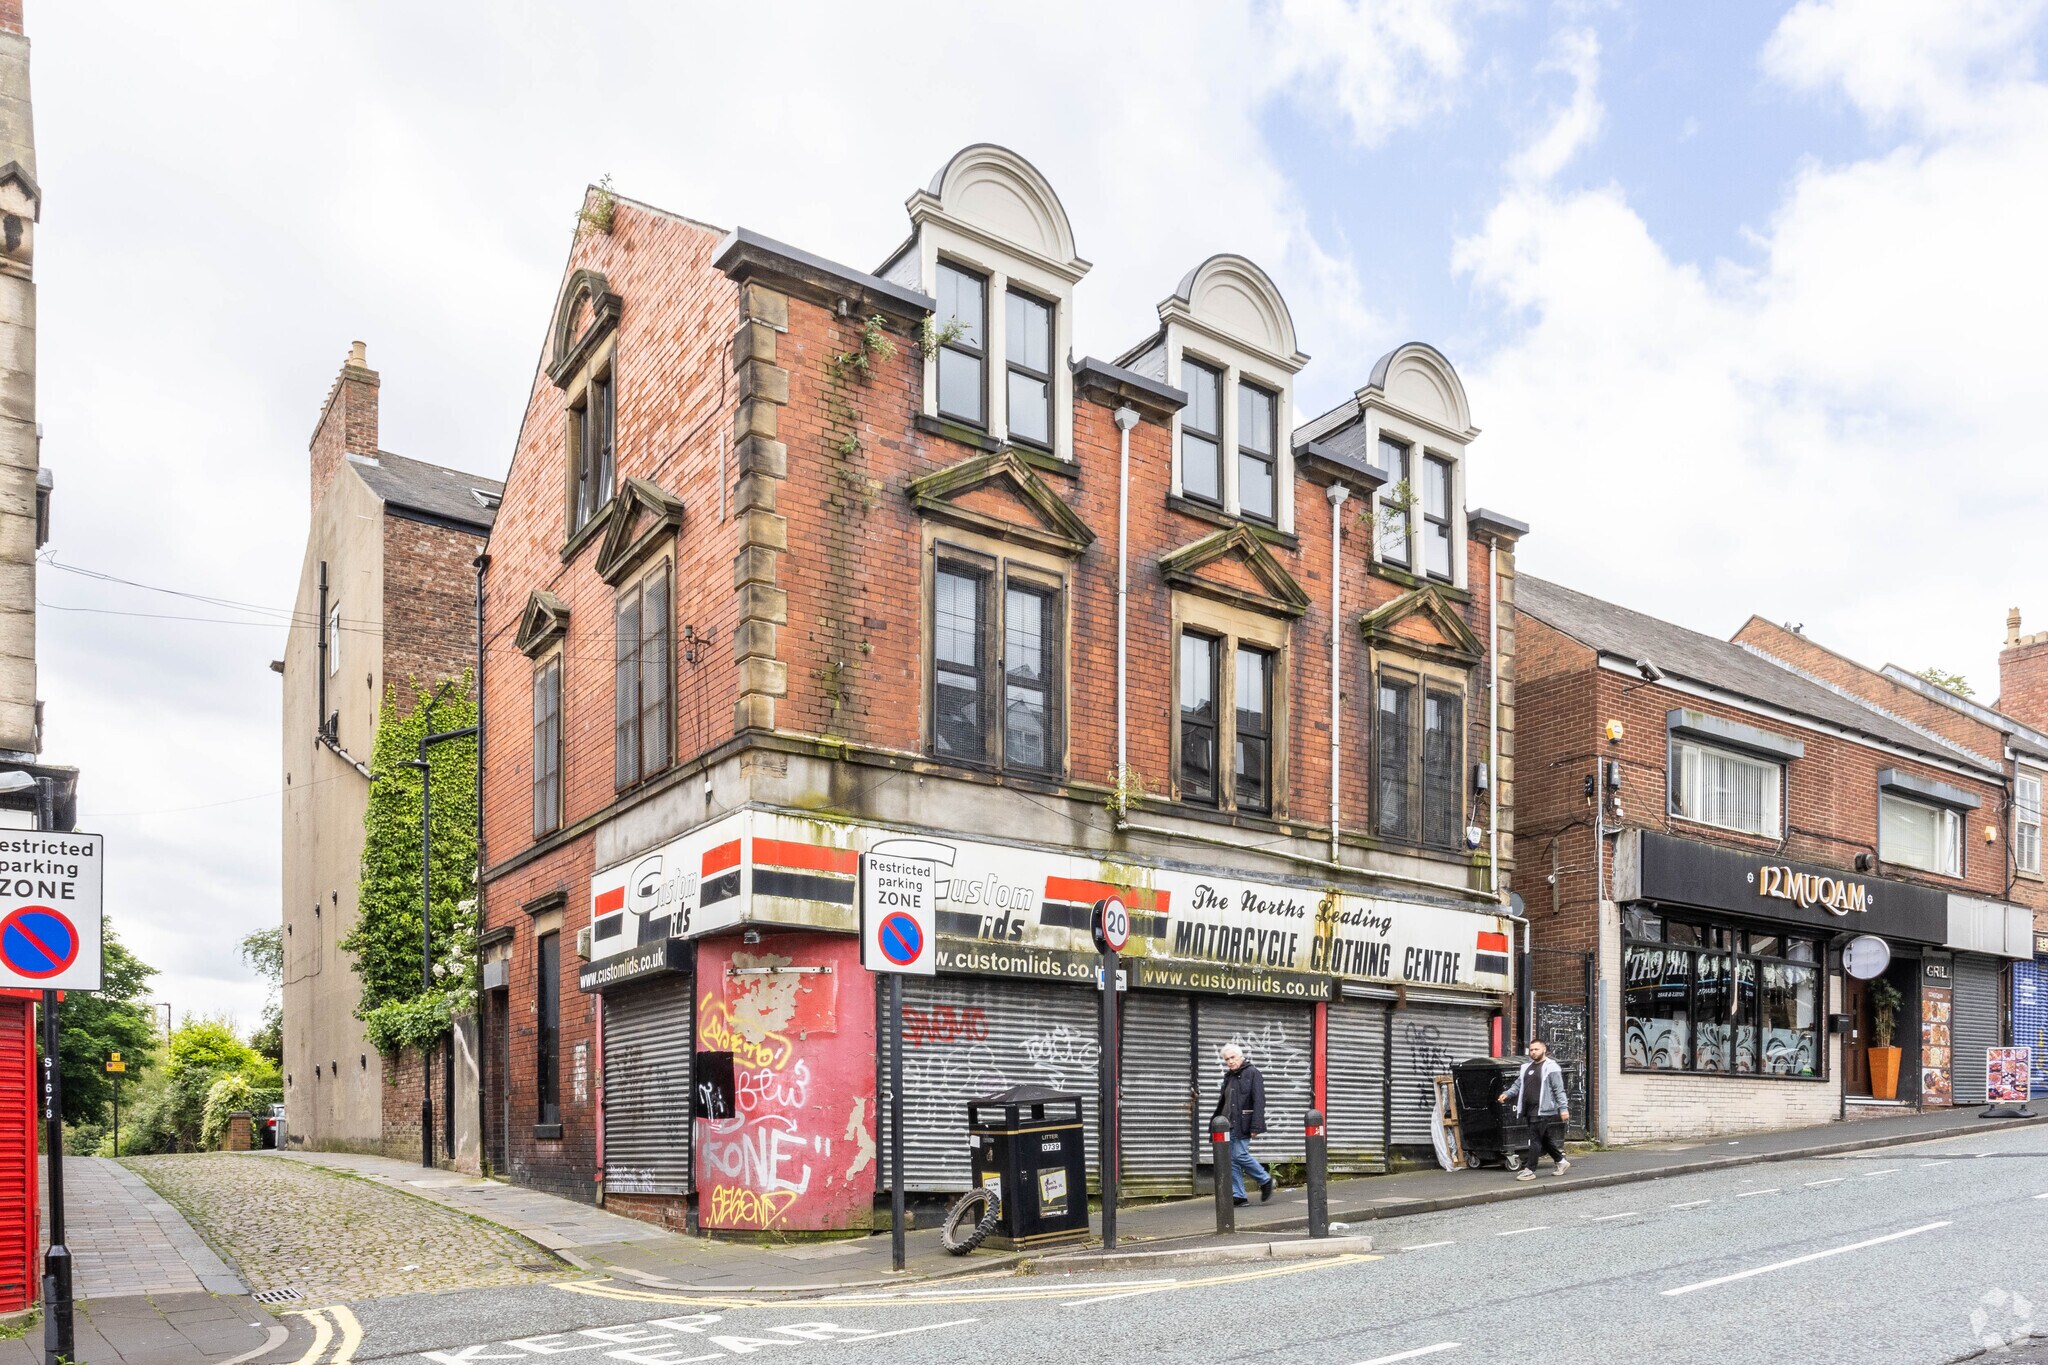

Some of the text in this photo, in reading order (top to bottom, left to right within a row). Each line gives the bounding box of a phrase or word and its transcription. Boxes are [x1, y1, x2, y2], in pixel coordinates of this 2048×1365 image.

[0, 859, 78, 878] parking
[870, 859, 931, 877] Restricted
[0, 878, 75, 900] ZONE
[878, 876, 923, 892] parking
[878, 890, 921, 908] ZONE
[1192, 884, 1392, 937] The Norths Leading
[1107, 910, 1126, 936] 20
[1174, 920, 1460, 985] MOTORCYCLE CLOTHING CENTRE
[580, 947, 664, 989] www.customlids.co.uk
[1143, 968, 1329, 998] www.customlids.co.uk
[44, 1057, 53, 1119] S1678
[1043, 1143, 1060, 1151] 0739
[420, 1314, 723, 1365] KEEP
